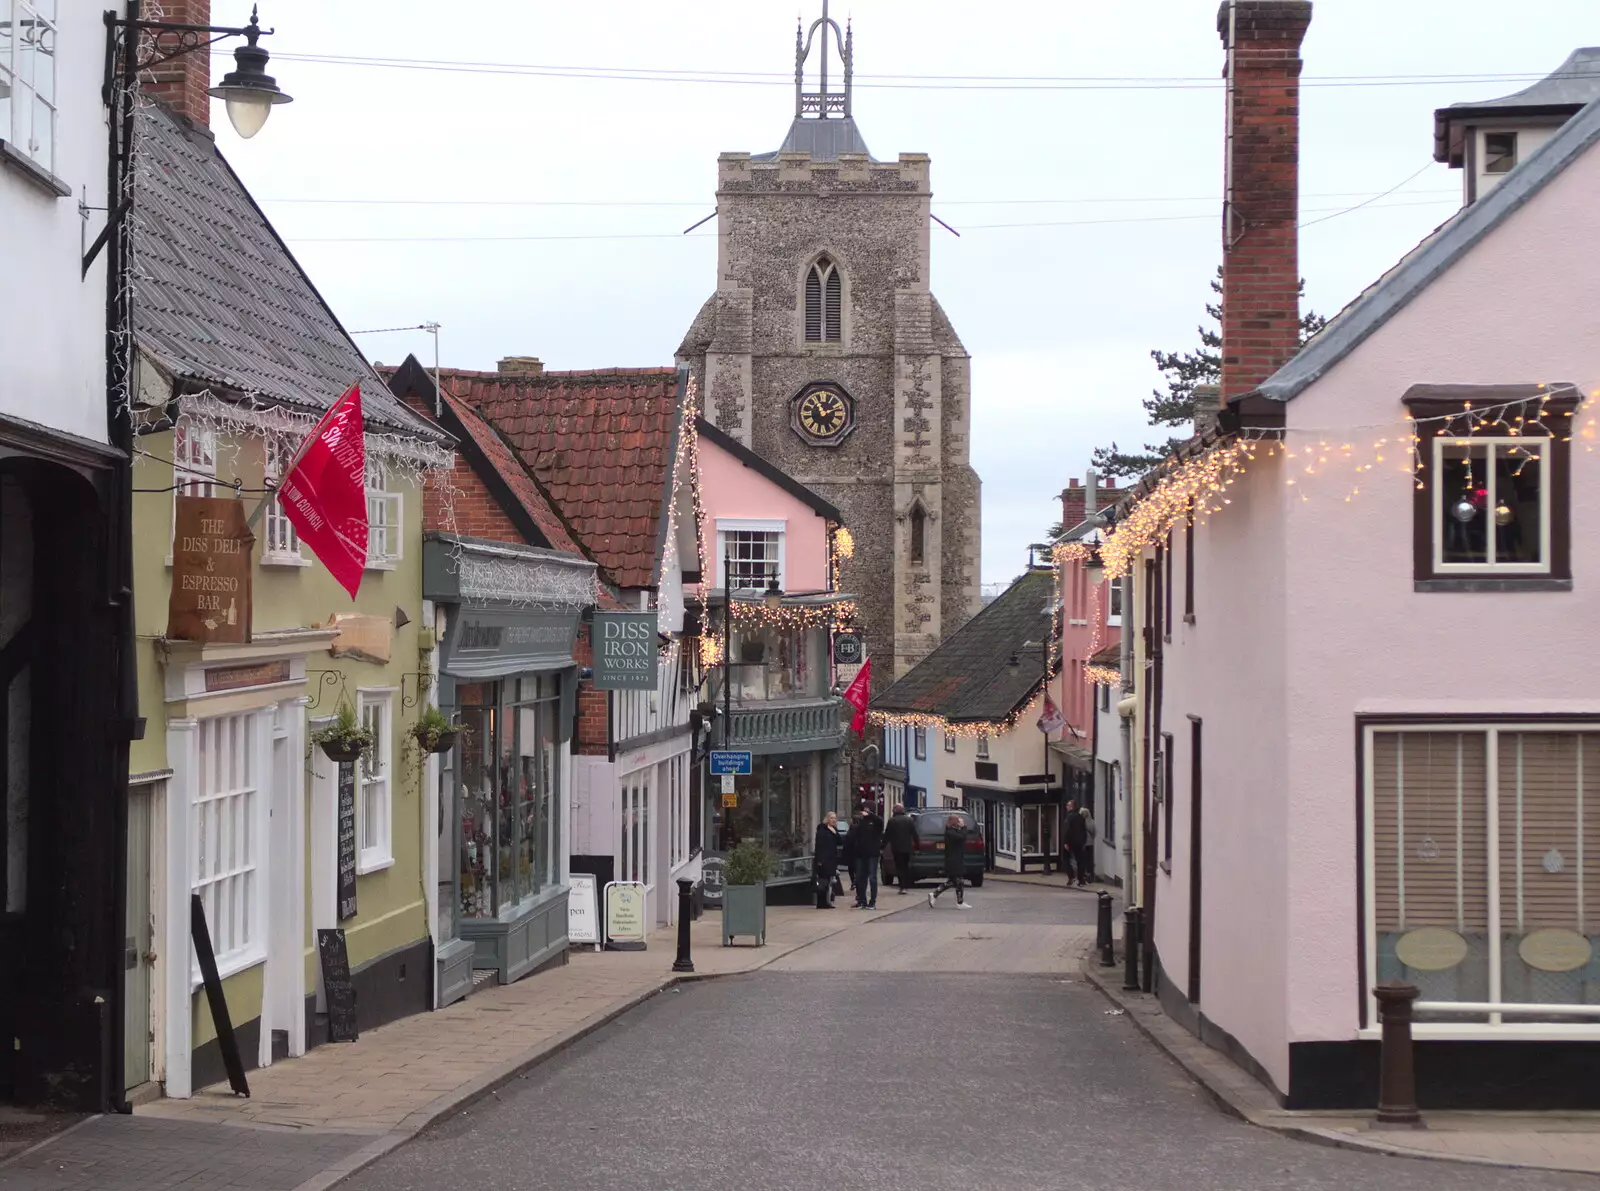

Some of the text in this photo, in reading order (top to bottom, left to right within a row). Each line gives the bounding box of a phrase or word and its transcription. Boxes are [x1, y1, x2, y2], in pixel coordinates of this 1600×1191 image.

[296, 498, 325, 533] COUNCIL
[200, 519, 225, 535] THE
[182, 538, 241, 554] DISS DELI
[205, 557, 214, 570] &
[181, 575, 238, 592] ESPRESSO
[197, 595, 220, 610] BAR
[604, 621, 649, 639] DISS
[604, 641, 649, 656] IRON
[604, 659, 649, 670] WORKS
[569, 908, 586, 917] pen
